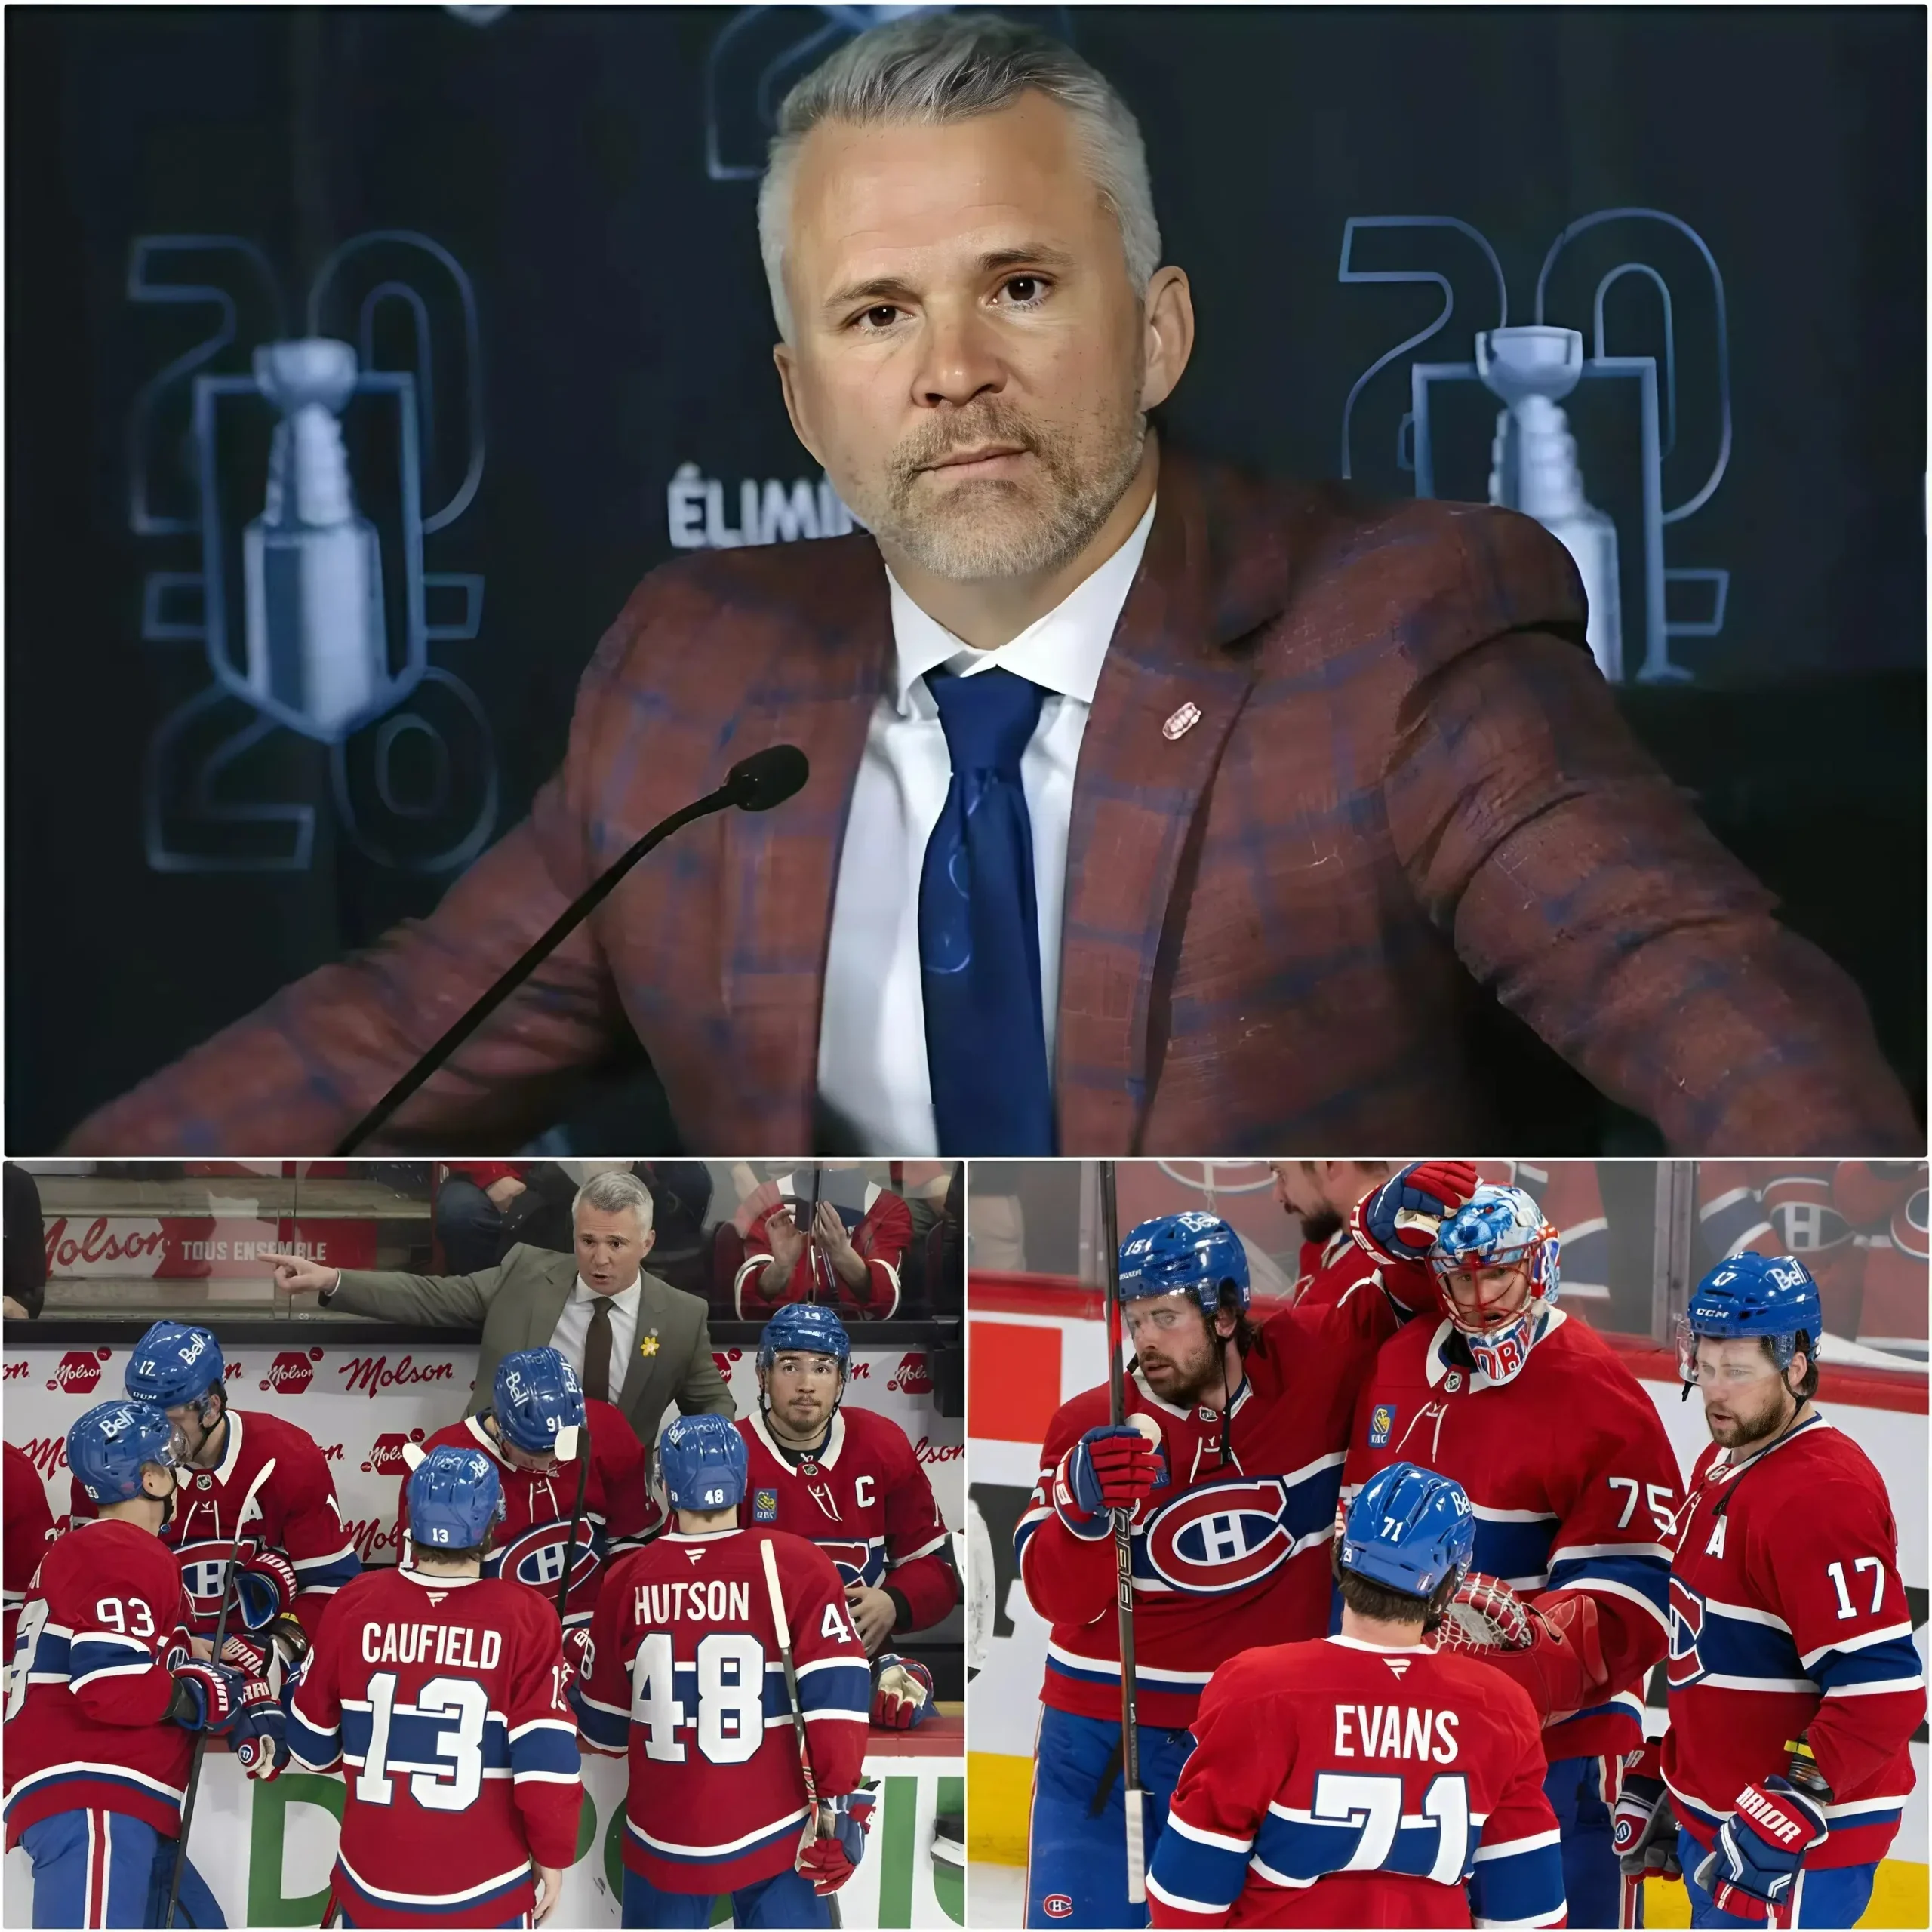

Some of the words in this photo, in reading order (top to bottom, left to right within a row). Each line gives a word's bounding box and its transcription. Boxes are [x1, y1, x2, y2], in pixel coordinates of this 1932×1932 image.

[182, 1241, 227, 1261] TOUS
[233, 1241, 327, 1261] ENSEMBLE
[1769, 1260, 1807, 1291] Bell
[1696, 1308, 1730, 1318] CCM
[178, 1333, 205, 1365] Bell
[55, 1364, 101, 1386] Molson
[268, 1364, 314, 1386] Molson
[338, 1355, 454, 1399] Molson
[506, 1371, 529, 1407] Bell
[99, 1407, 136, 1438] Bell
[546, 1414, 565, 1432] 91
[704, 1489, 724, 1504] 48
[855, 1475, 875, 1508] C
[1607, 1476, 1678, 1537] 75
[432, 1528, 449, 1543] 13
[1380, 1516, 1404, 1543] 71
[1704, 1514, 1728, 1560] A
[635, 1580, 749, 1626] HUTSON
[1827, 1555, 1887, 1620] 17
[96, 1597, 155, 1637] 93
[820, 1603, 863, 1644] 4
[361, 1622, 503, 1670] CAUFIELD
[630, 1630, 764, 1765] 48
[355, 1671, 489, 1812] 13
[1334, 1704, 1460, 1764] EVANS
[1312, 1770, 1471, 1887] 71
